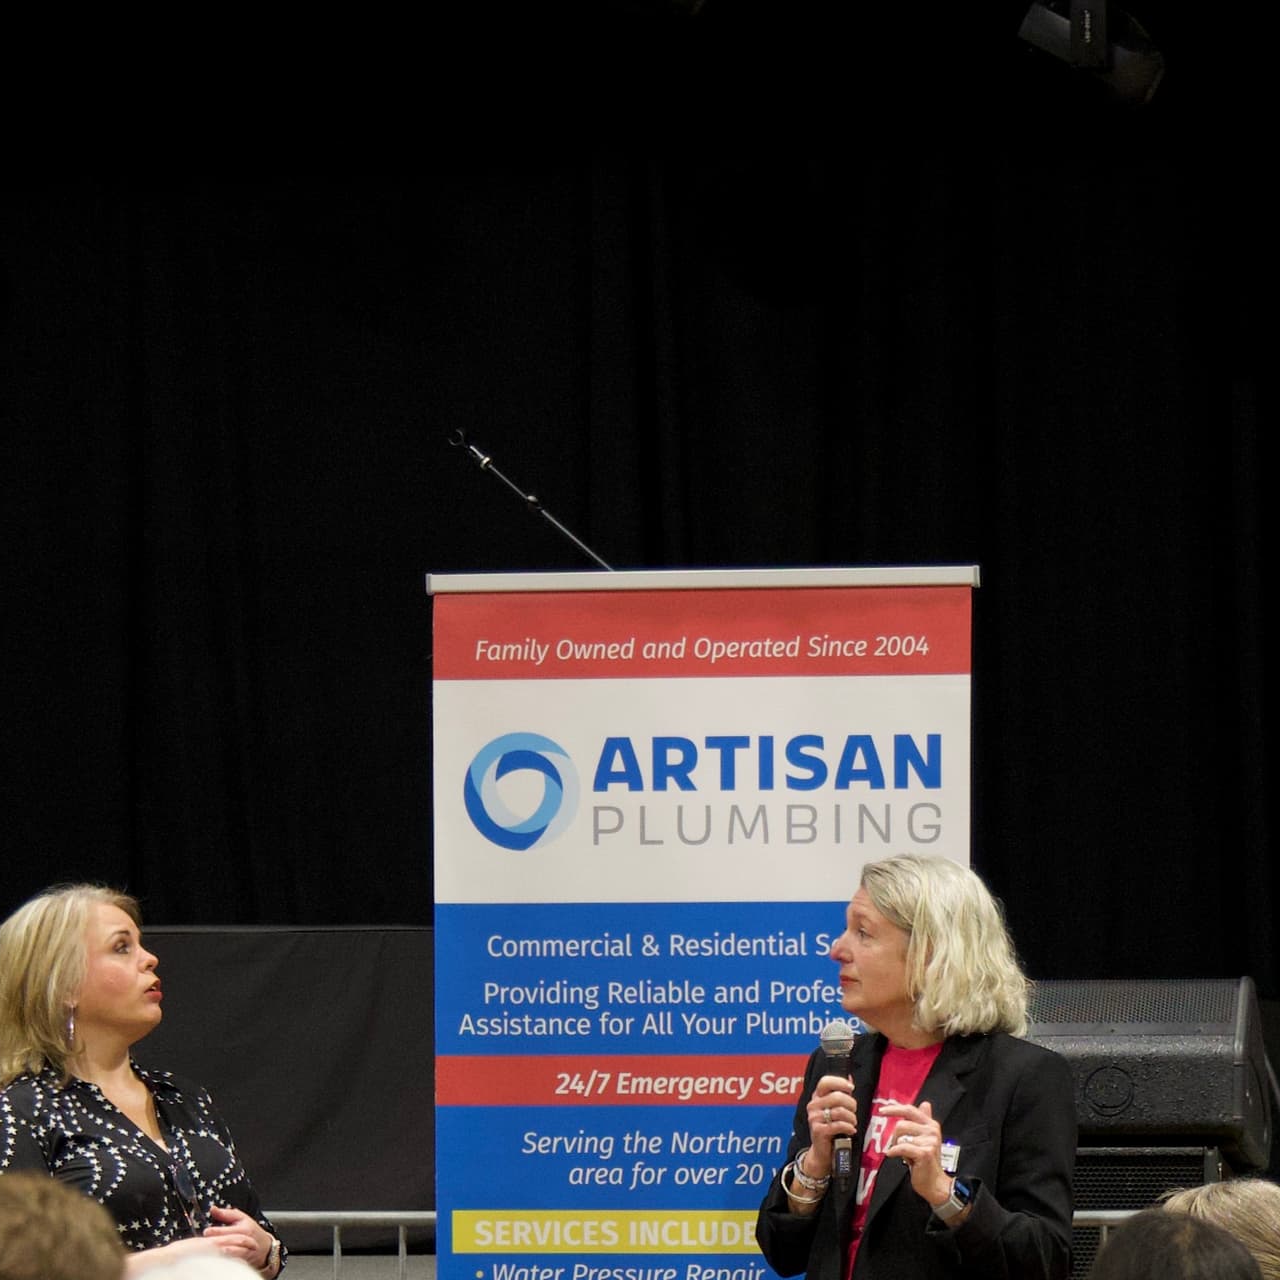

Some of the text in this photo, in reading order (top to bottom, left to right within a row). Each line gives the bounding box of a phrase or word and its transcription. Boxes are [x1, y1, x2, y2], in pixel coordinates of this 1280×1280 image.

[475, 634, 929, 666] Family Owned and Operated Since 2004
[592, 732, 943, 793] ARTISAN
[592, 802, 942, 846] PLUMBING
[487, 931, 838, 958] Commercial & Residential S
[484, 979, 600, 1010] Providing
[608, 979, 705, 1004] Reliable
[714, 980, 760, 1004] and
[458, 1010, 864, 1037] Assistance for All Your Plumbig
[555, 1069, 804, 1101] 24/7 Emergency Ser
[521, 1129, 615, 1159] Serving
[623, 1130, 663, 1154] the
[671, 1130, 782, 1154] Northern
[568, 1167, 623, 1185] area
[629, 1161, 668, 1190] for
[674, 1167, 729, 1185] over
[734, 1163, 764, 1185] 20
[475, 1220, 619, 1246] SERVICES
